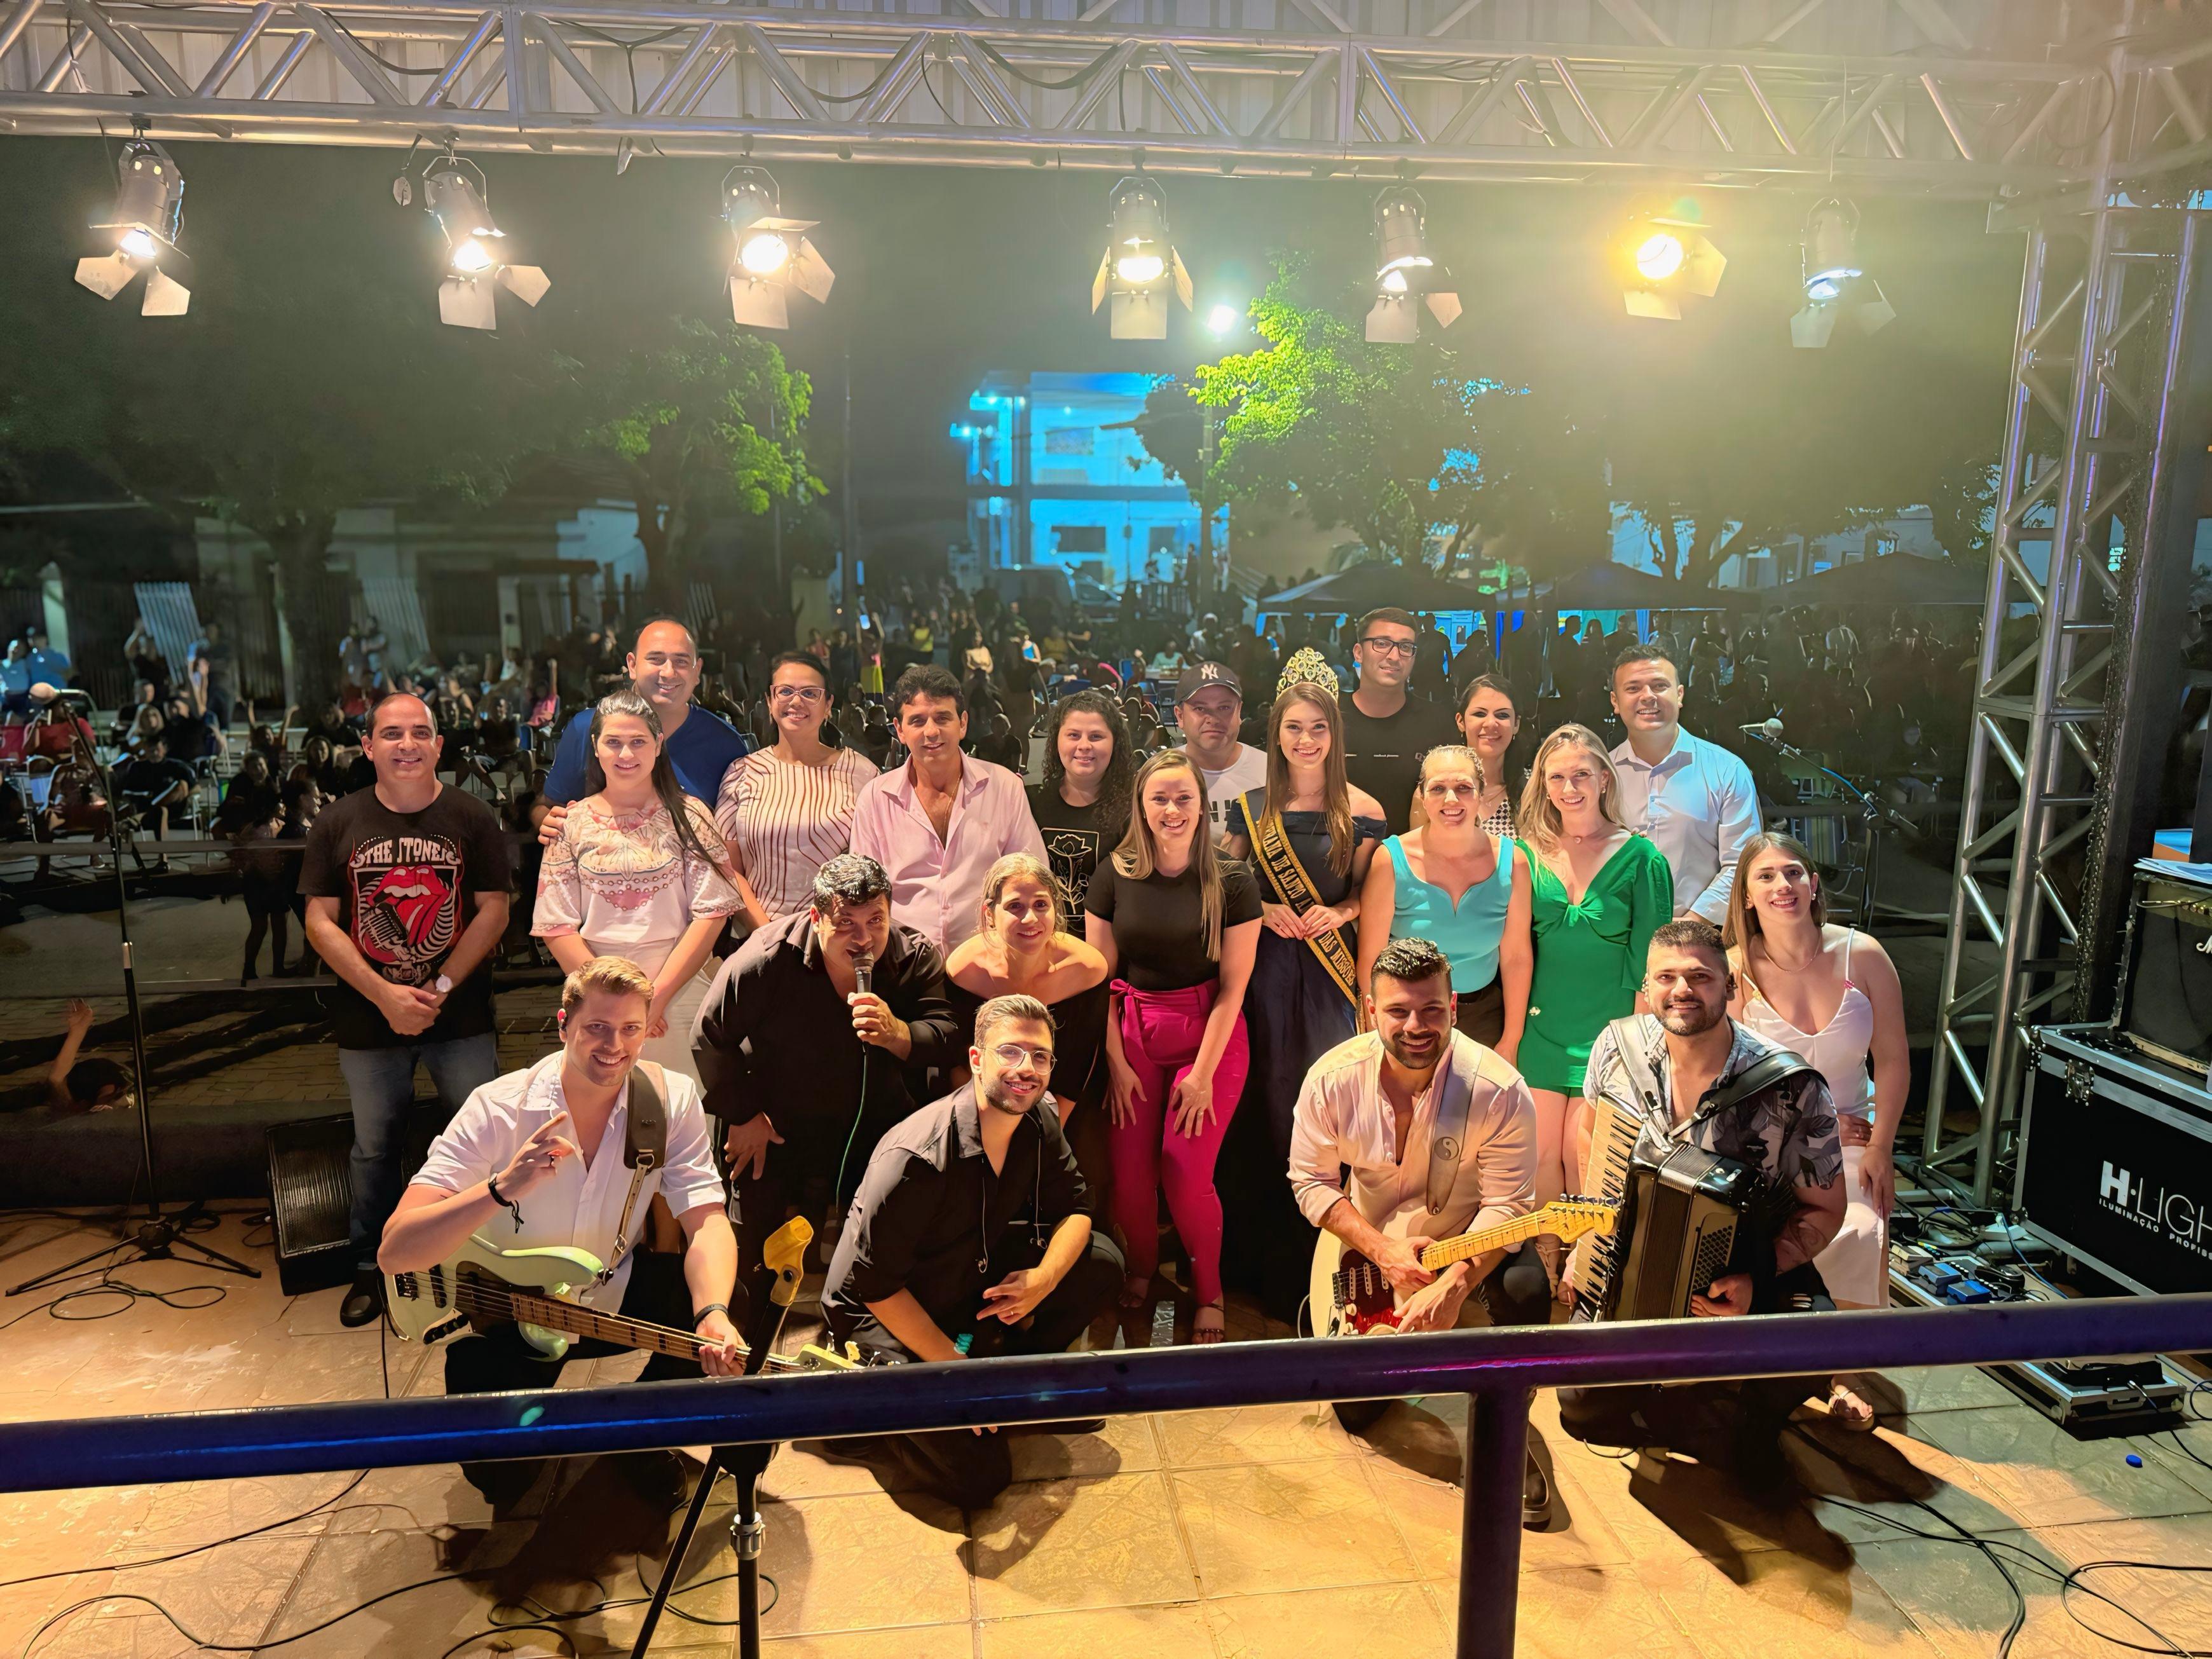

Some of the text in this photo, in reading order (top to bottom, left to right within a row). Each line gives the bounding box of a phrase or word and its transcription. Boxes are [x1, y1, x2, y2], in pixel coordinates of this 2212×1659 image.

[1201, 664, 1219, 679] NY
[365, 837, 447, 864] THE STONES
[1271, 855, 1291, 871] DE
[1278, 868, 1306, 899] SANTO
[1318, 930, 1337, 953] DAS
